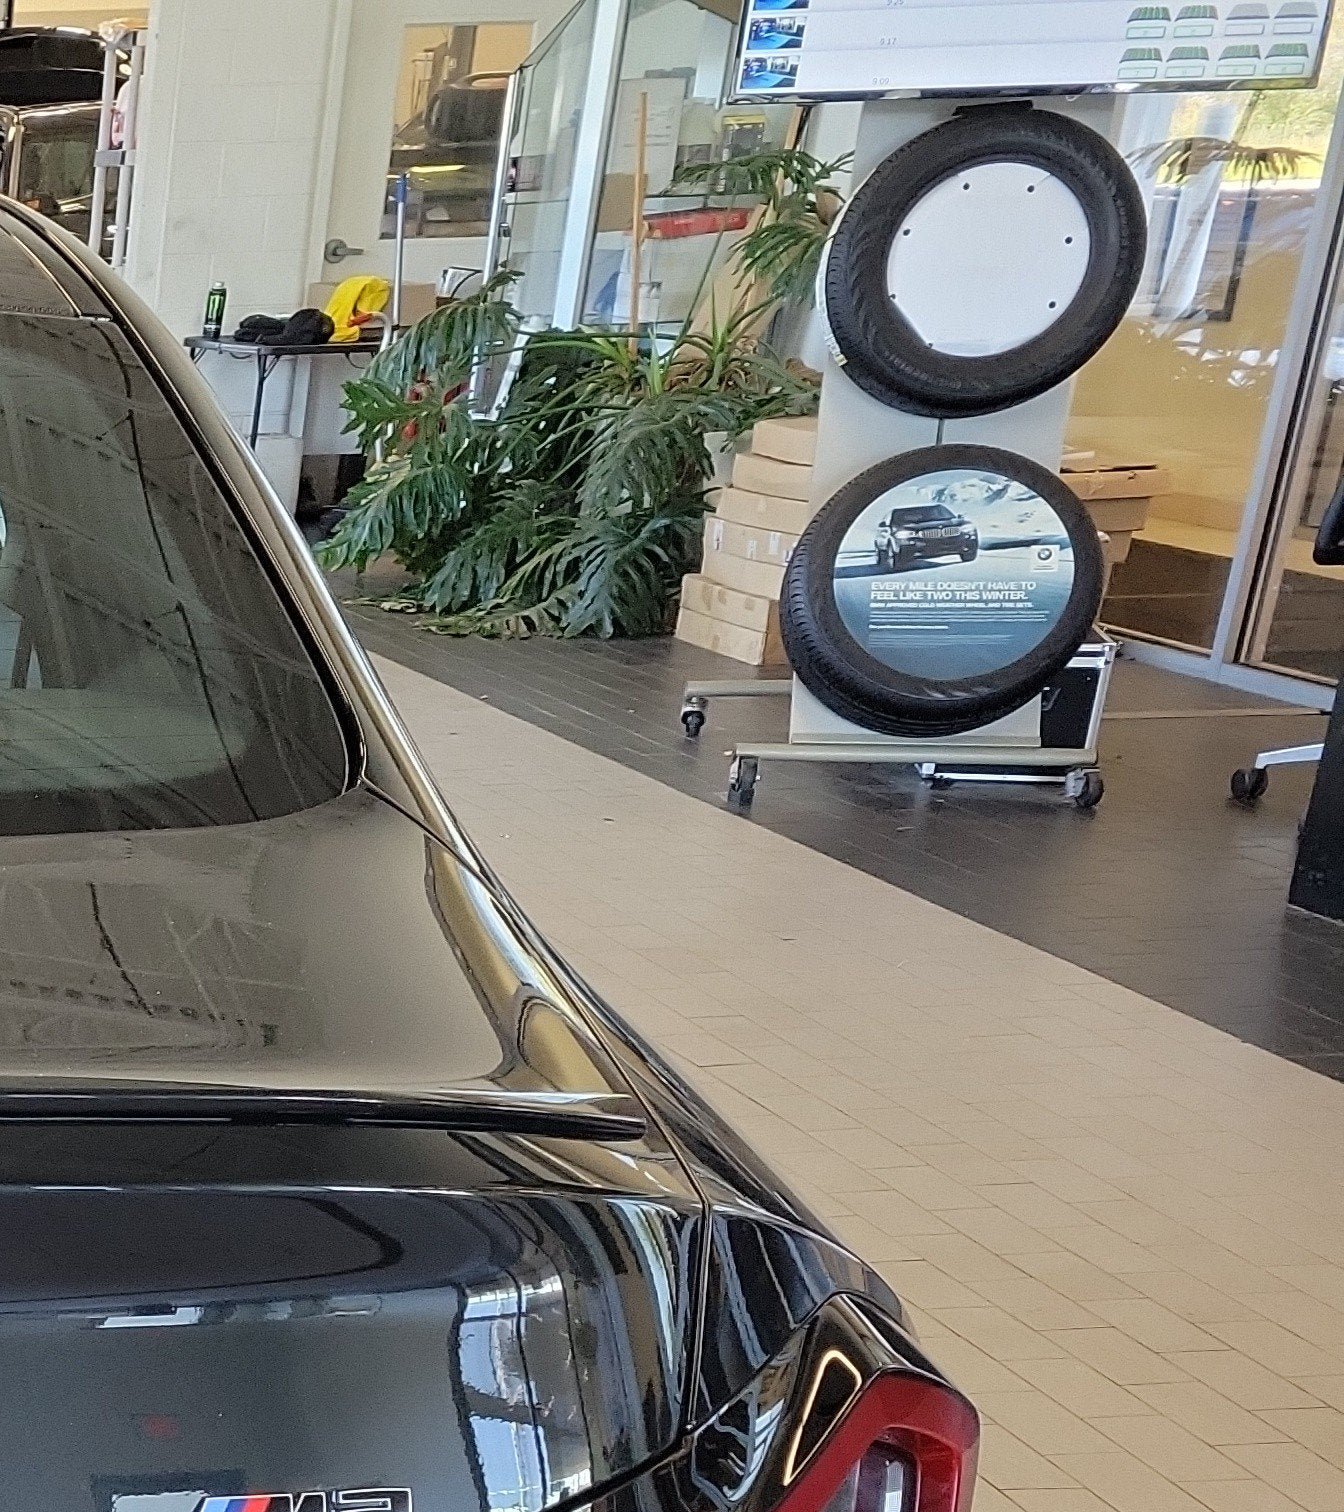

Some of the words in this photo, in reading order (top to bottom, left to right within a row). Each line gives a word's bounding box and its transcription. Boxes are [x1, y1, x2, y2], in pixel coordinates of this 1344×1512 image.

[871, 581, 906, 590] EVERY
[909, 581, 936, 590] MILE
[937, 581, 986, 590] DOESN'T
[987, 581, 1018, 590] HAVE
[1020, 581, 1037, 590] TO
[870, 591, 898, 600] FEEL
[899, 591, 924, 600] LIKE
[925, 591, 952, 600] TWO
[954, 591, 980, 600] THIS
[982, 591, 1029, 600] WINTER.
